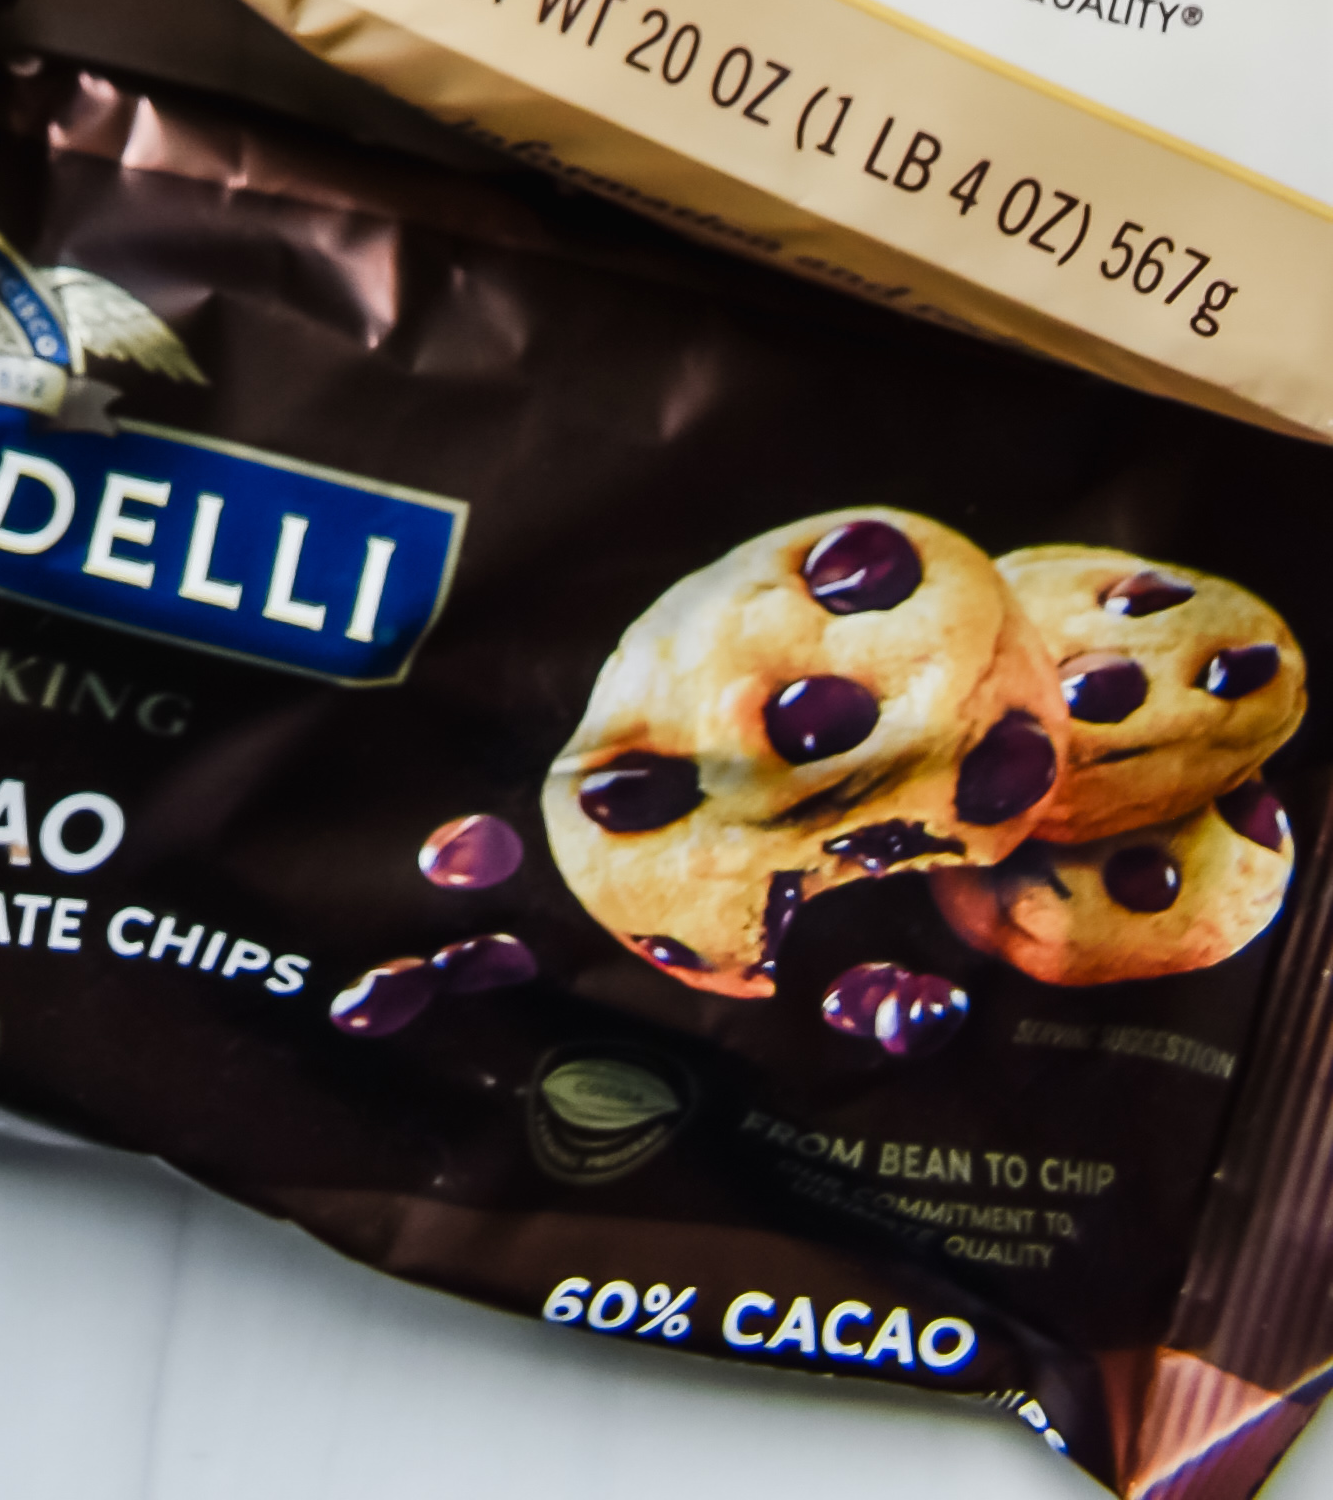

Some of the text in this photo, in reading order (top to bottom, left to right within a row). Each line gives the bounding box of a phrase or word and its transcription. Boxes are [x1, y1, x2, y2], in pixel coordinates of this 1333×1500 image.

[623, 5, 705, 88] 20
[709, 44, 794, 128] OZ
[793, 83, 857, 158] (1
[861, 114, 944, 195] LB
[947, 156, 995, 219] 4
[1097, 217, 1241, 339] 567g
[105, 905, 312, 997] CHIPS
[878, 1141, 973, 1185] BEAN
[984, 1151, 1029, 1189] TO
[1038, 1157, 1117, 1196] CHIP
[542, 1275, 981, 1373] 60% CACAO
